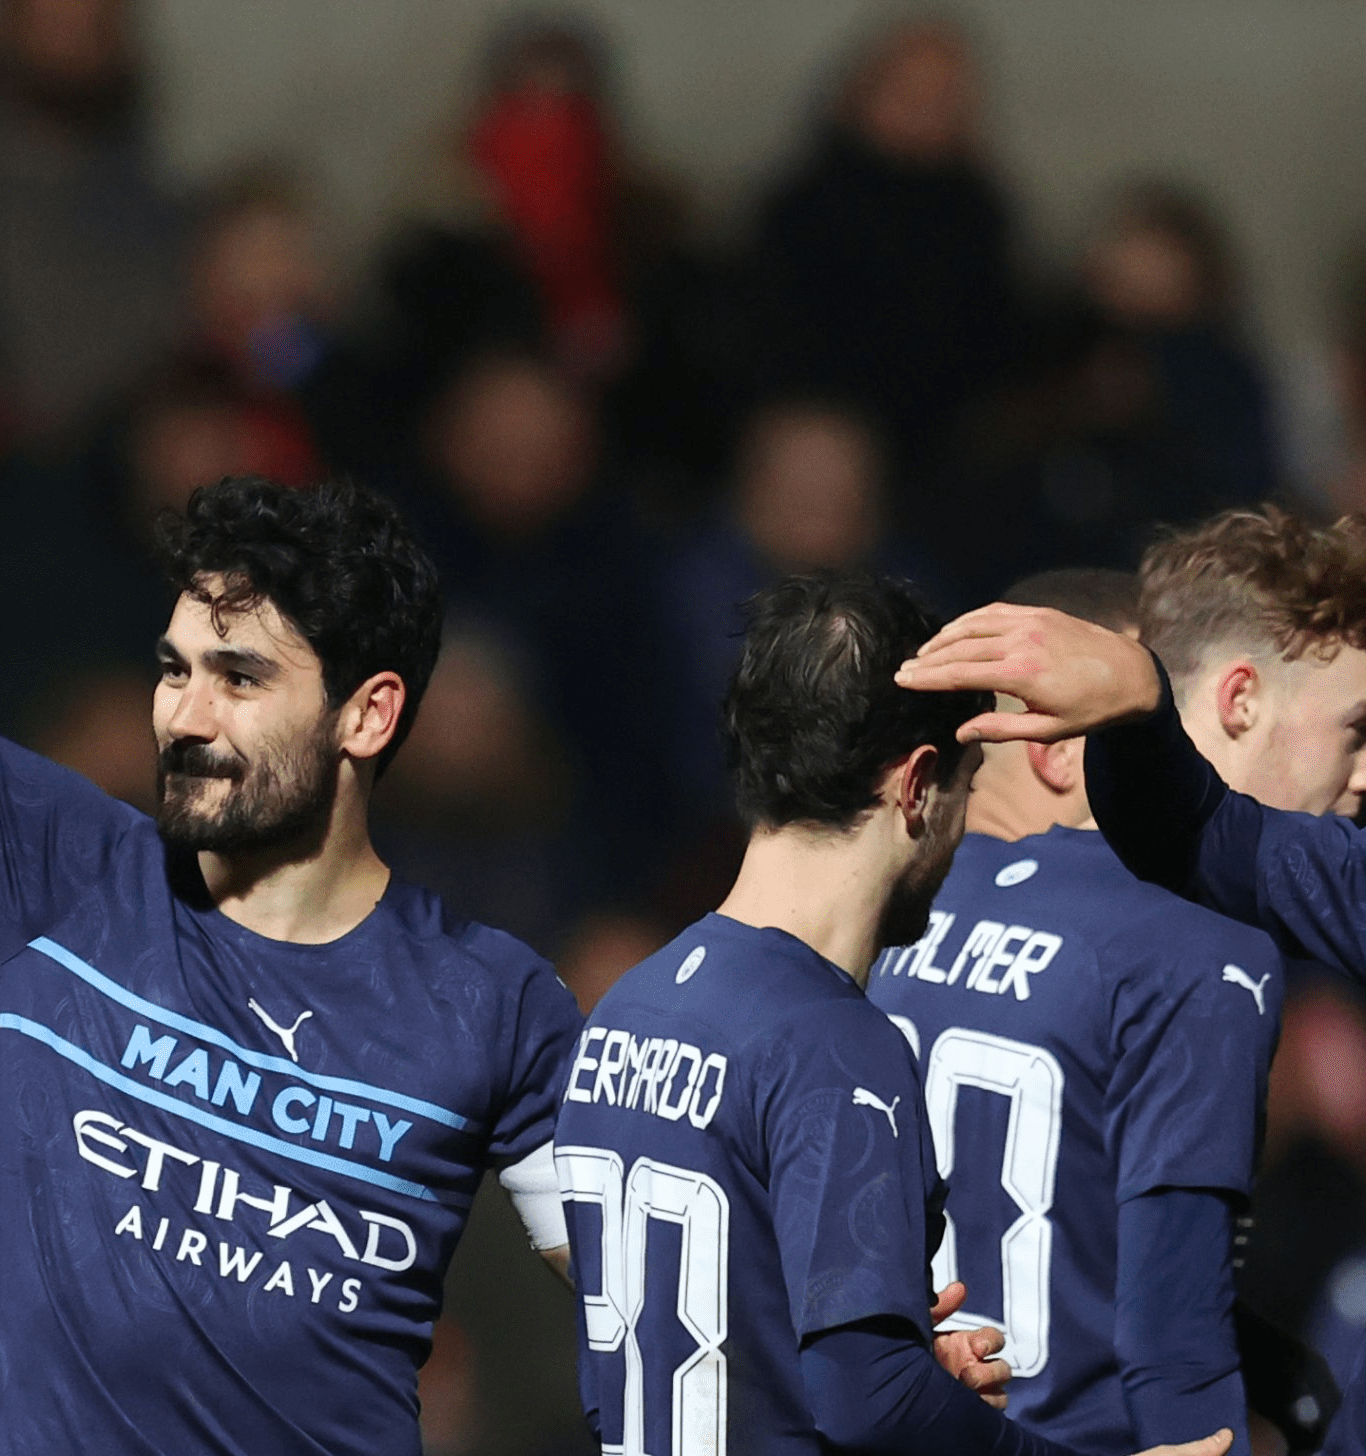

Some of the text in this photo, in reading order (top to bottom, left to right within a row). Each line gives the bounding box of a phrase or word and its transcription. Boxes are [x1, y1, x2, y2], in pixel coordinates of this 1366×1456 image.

[879, 910, 1064, 1001] ALMER
[120, 1024, 413, 1162] MAN CITY
[563, 1026, 728, 1130] ERNARDO
[73, 1109, 418, 1272] ETIHAD
[114, 1205, 363, 1313] AIRWAYS
